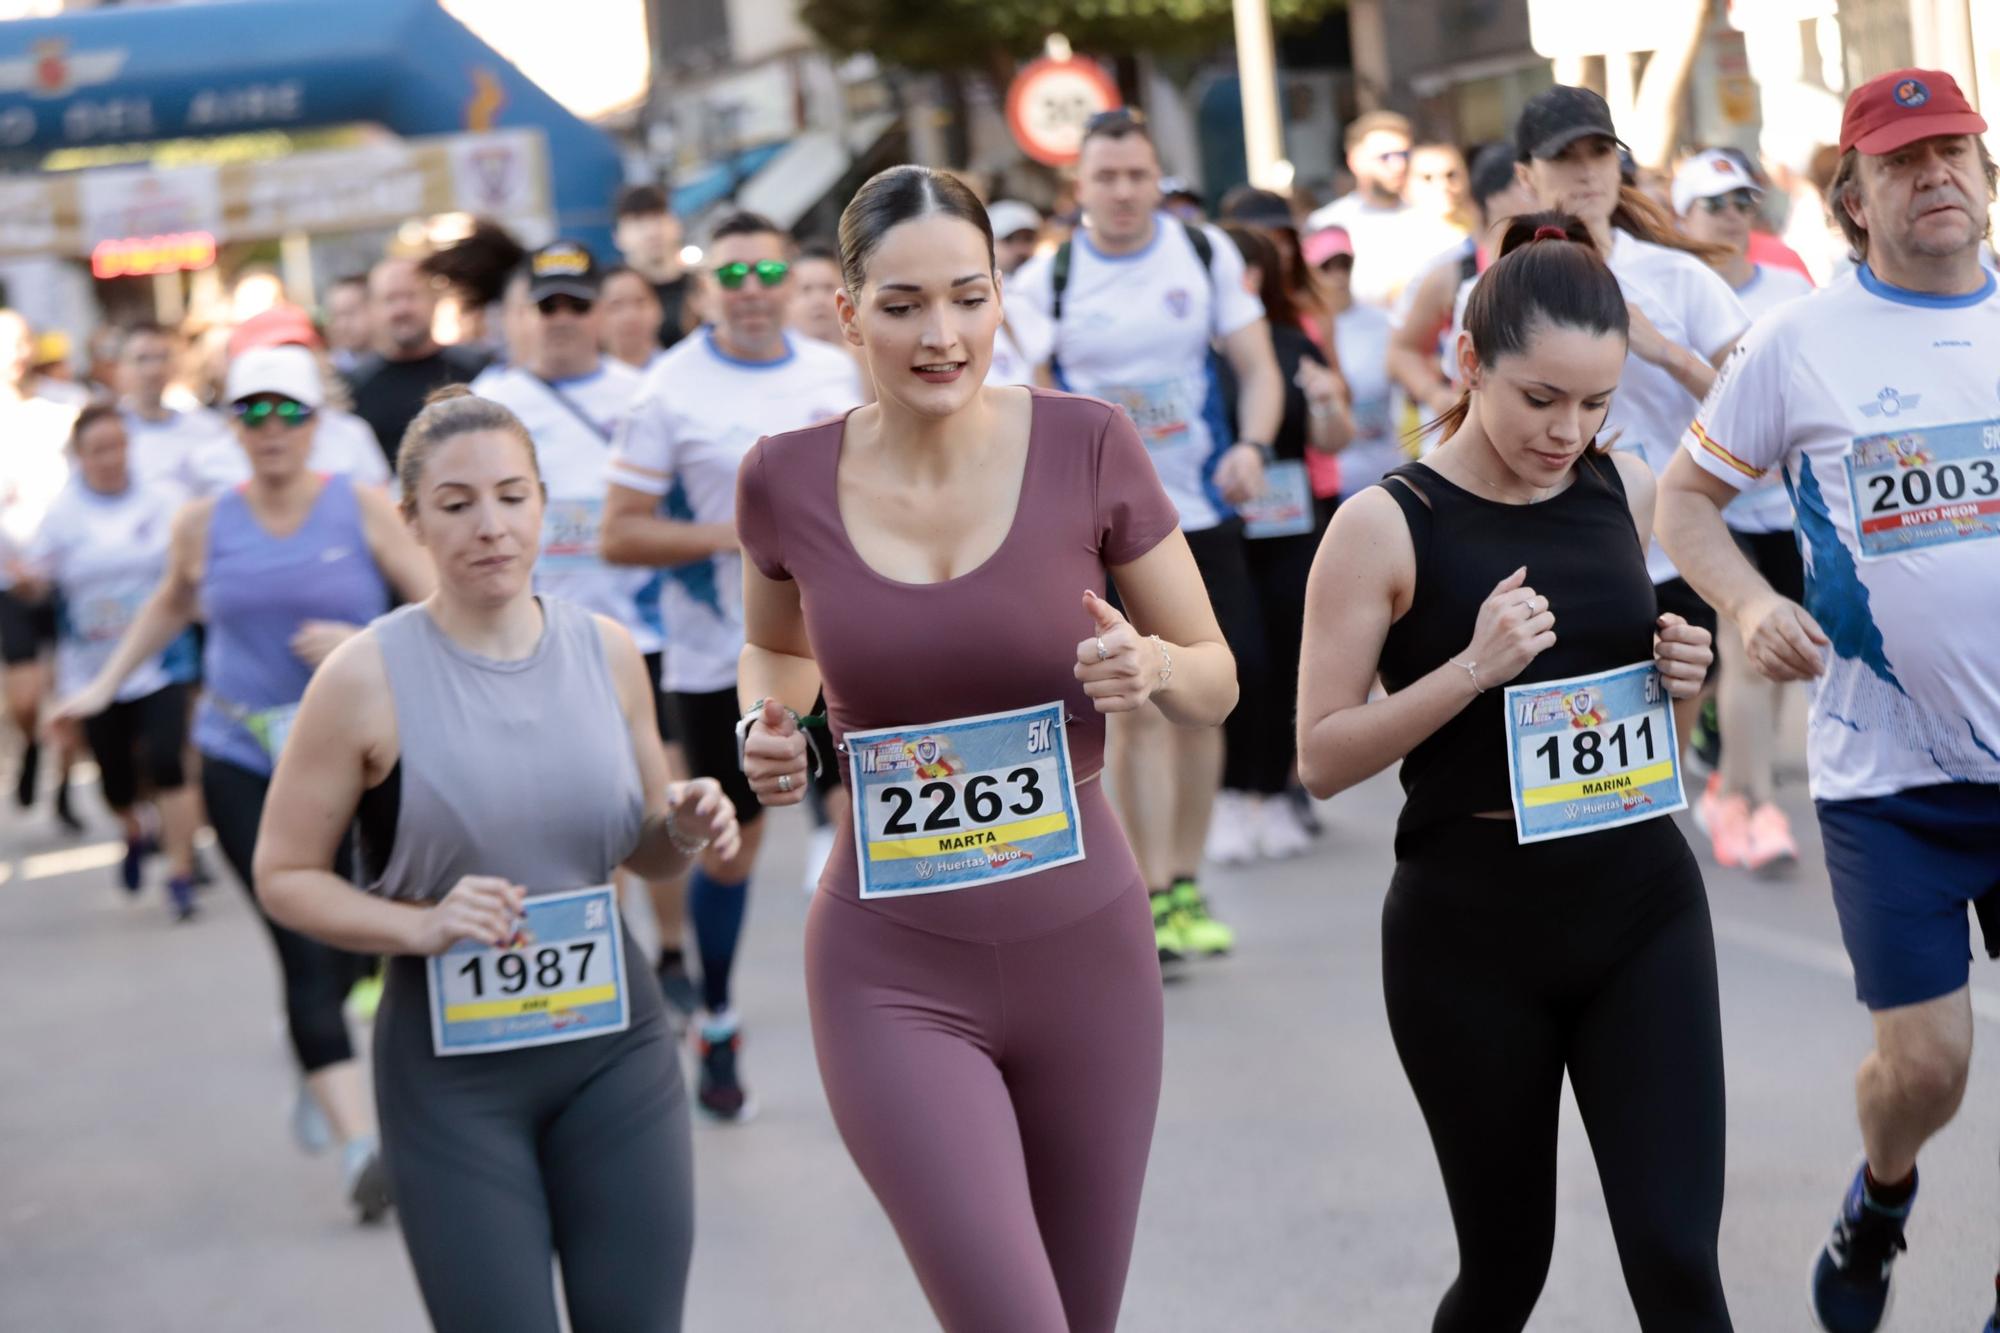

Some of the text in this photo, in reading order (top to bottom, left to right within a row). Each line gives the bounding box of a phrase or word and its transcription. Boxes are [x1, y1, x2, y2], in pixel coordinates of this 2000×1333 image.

[1868, 459, 2000, 513] 2003
[1901, 503, 1979, 527] RUTO NEON
[1028, 718, 1052, 754] 5K
[1536, 716, 1654, 780] 1811
[862, 749, 878, 774] IX
[1582, 776, 1632, 795] MARINA
[880, 766, 1044, 836] 2263
[1582, 801, 1621, 815] Huertas
[938, 831, 997, 851] MARTA
[937, 849, 1024, 873] Huertas Motor
[585, 899, 607, 930] 5K
[459, 941, 596, 997] 1987
